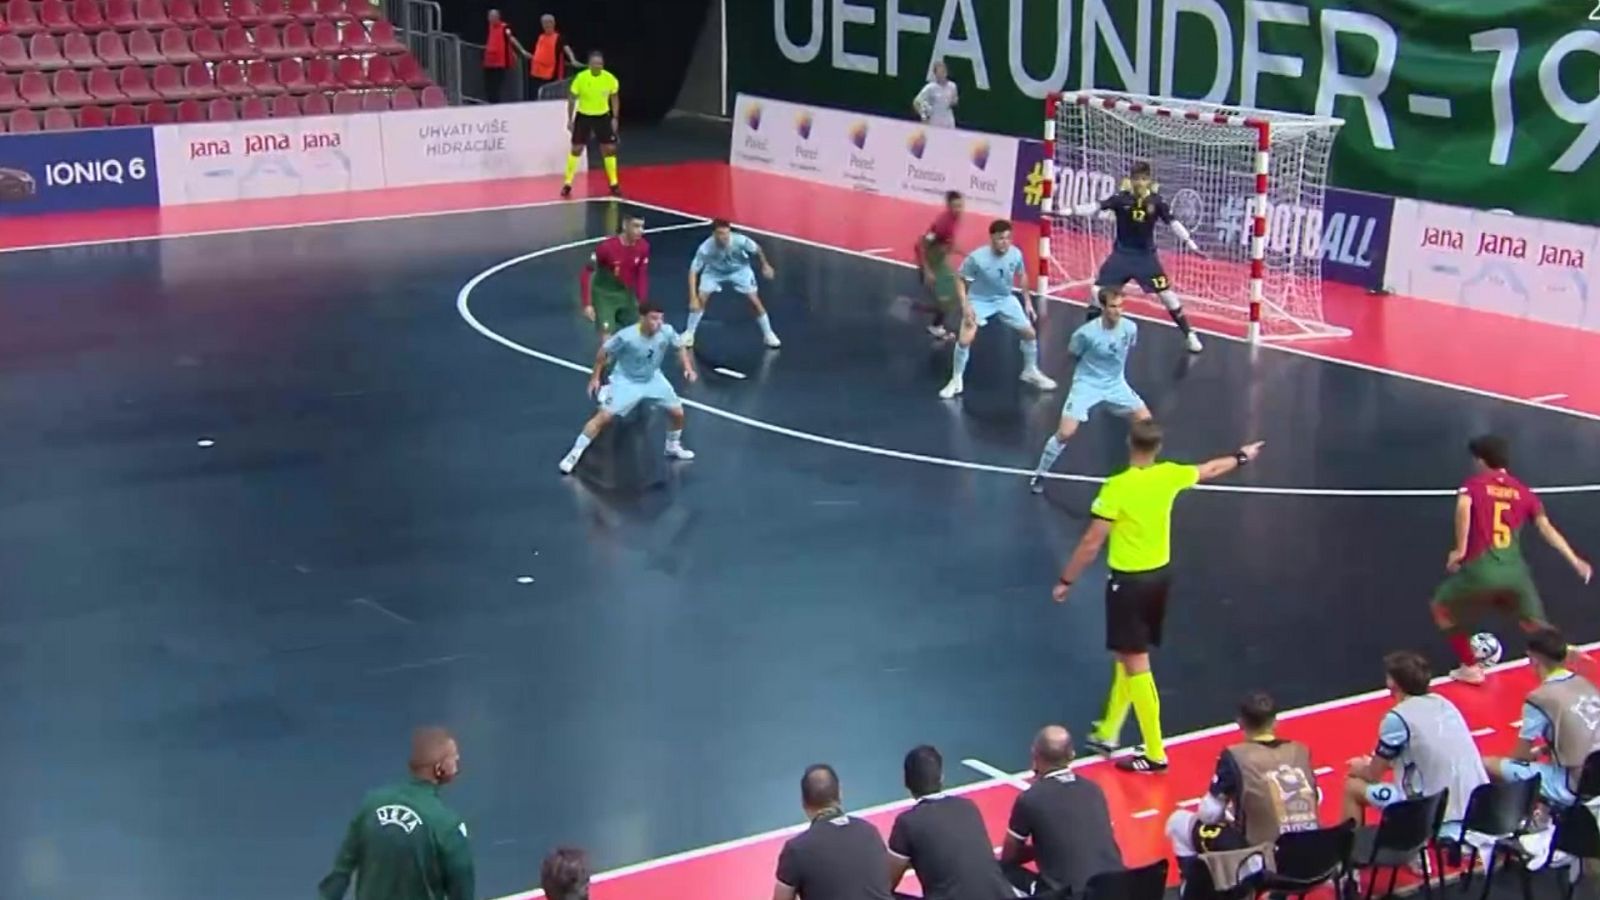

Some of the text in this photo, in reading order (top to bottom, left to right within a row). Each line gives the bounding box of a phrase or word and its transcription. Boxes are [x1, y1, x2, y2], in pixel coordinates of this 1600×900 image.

[774, 0, 991, 90] UEFA
[419, 123, 473, 140] UHVATI
[426, 137, 505, 157] HIDRACIJE
[45, 157, 147, 186] IONIQ 6
[1493, 501, 1512, 549] 5
[376, 805, 423, 834] UEFA
